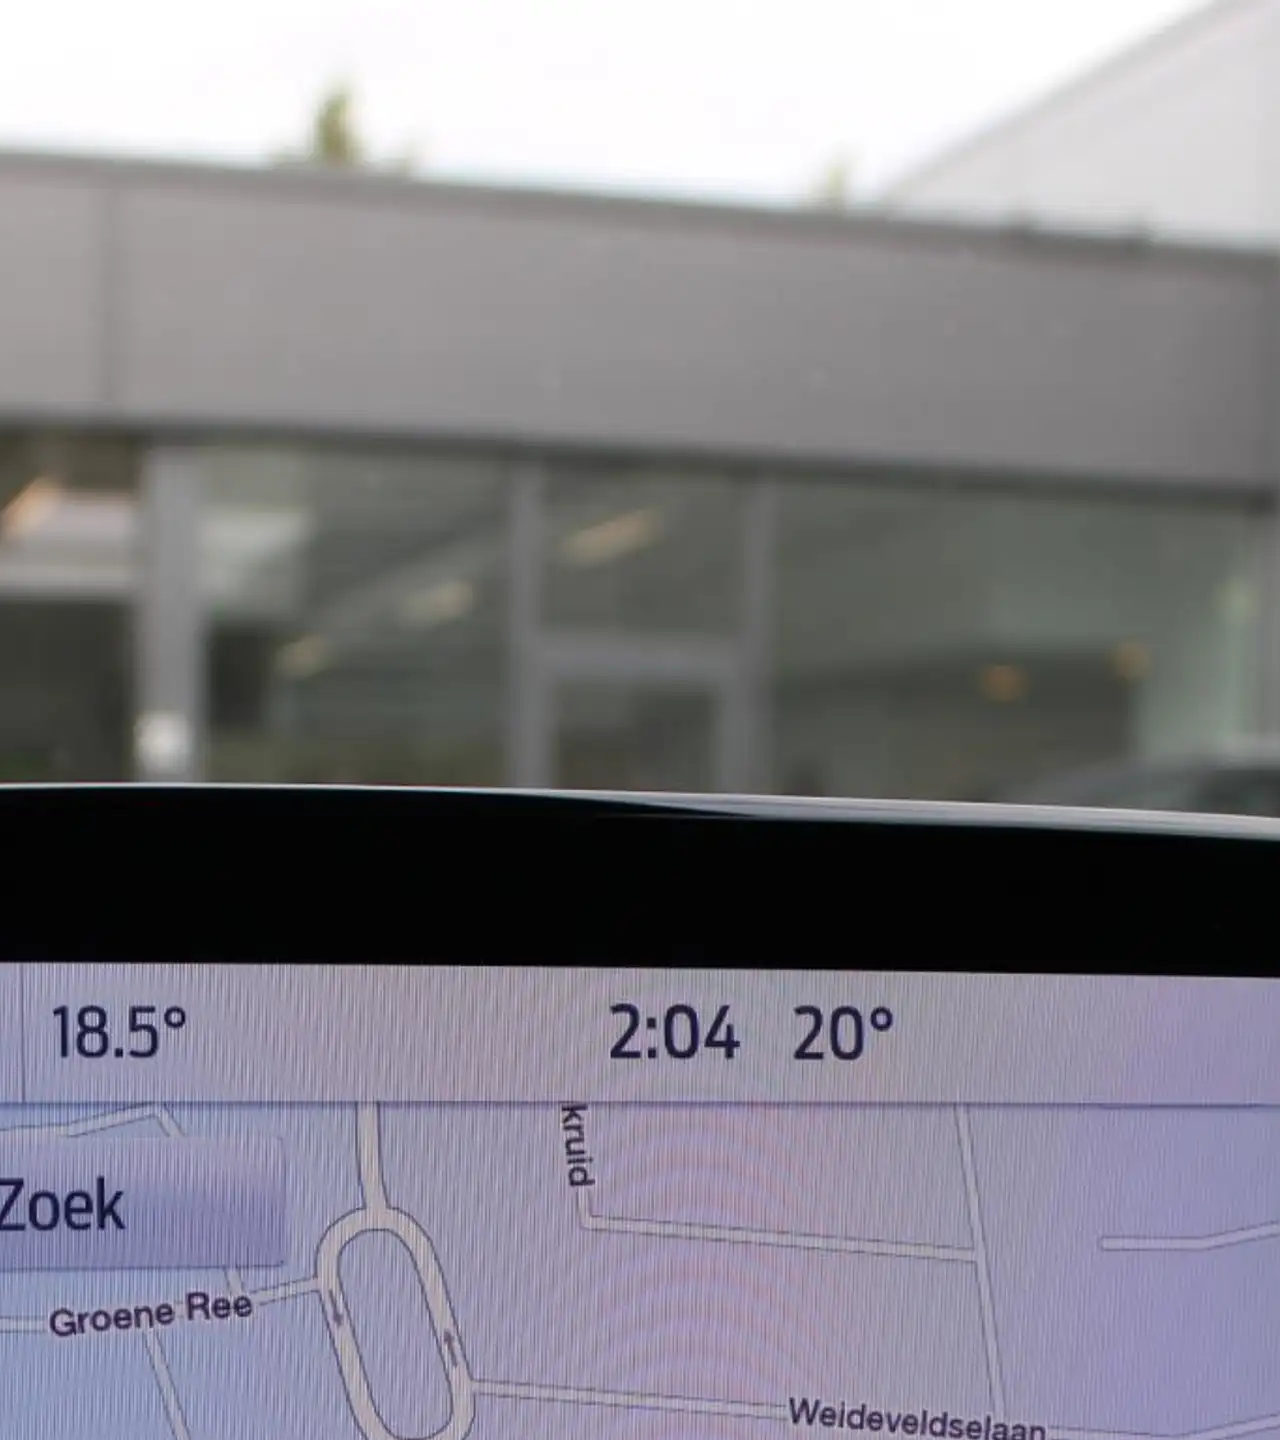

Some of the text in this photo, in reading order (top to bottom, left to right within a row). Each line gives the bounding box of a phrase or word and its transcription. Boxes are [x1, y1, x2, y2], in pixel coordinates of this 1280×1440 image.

[53, 1006, 186, 1058] 18.5°
[611, 1004, 740, 1059] 2:04
[794, 1006, 892, 1060] 20°
[50, 1292, 252, 1337] Groene Ree
